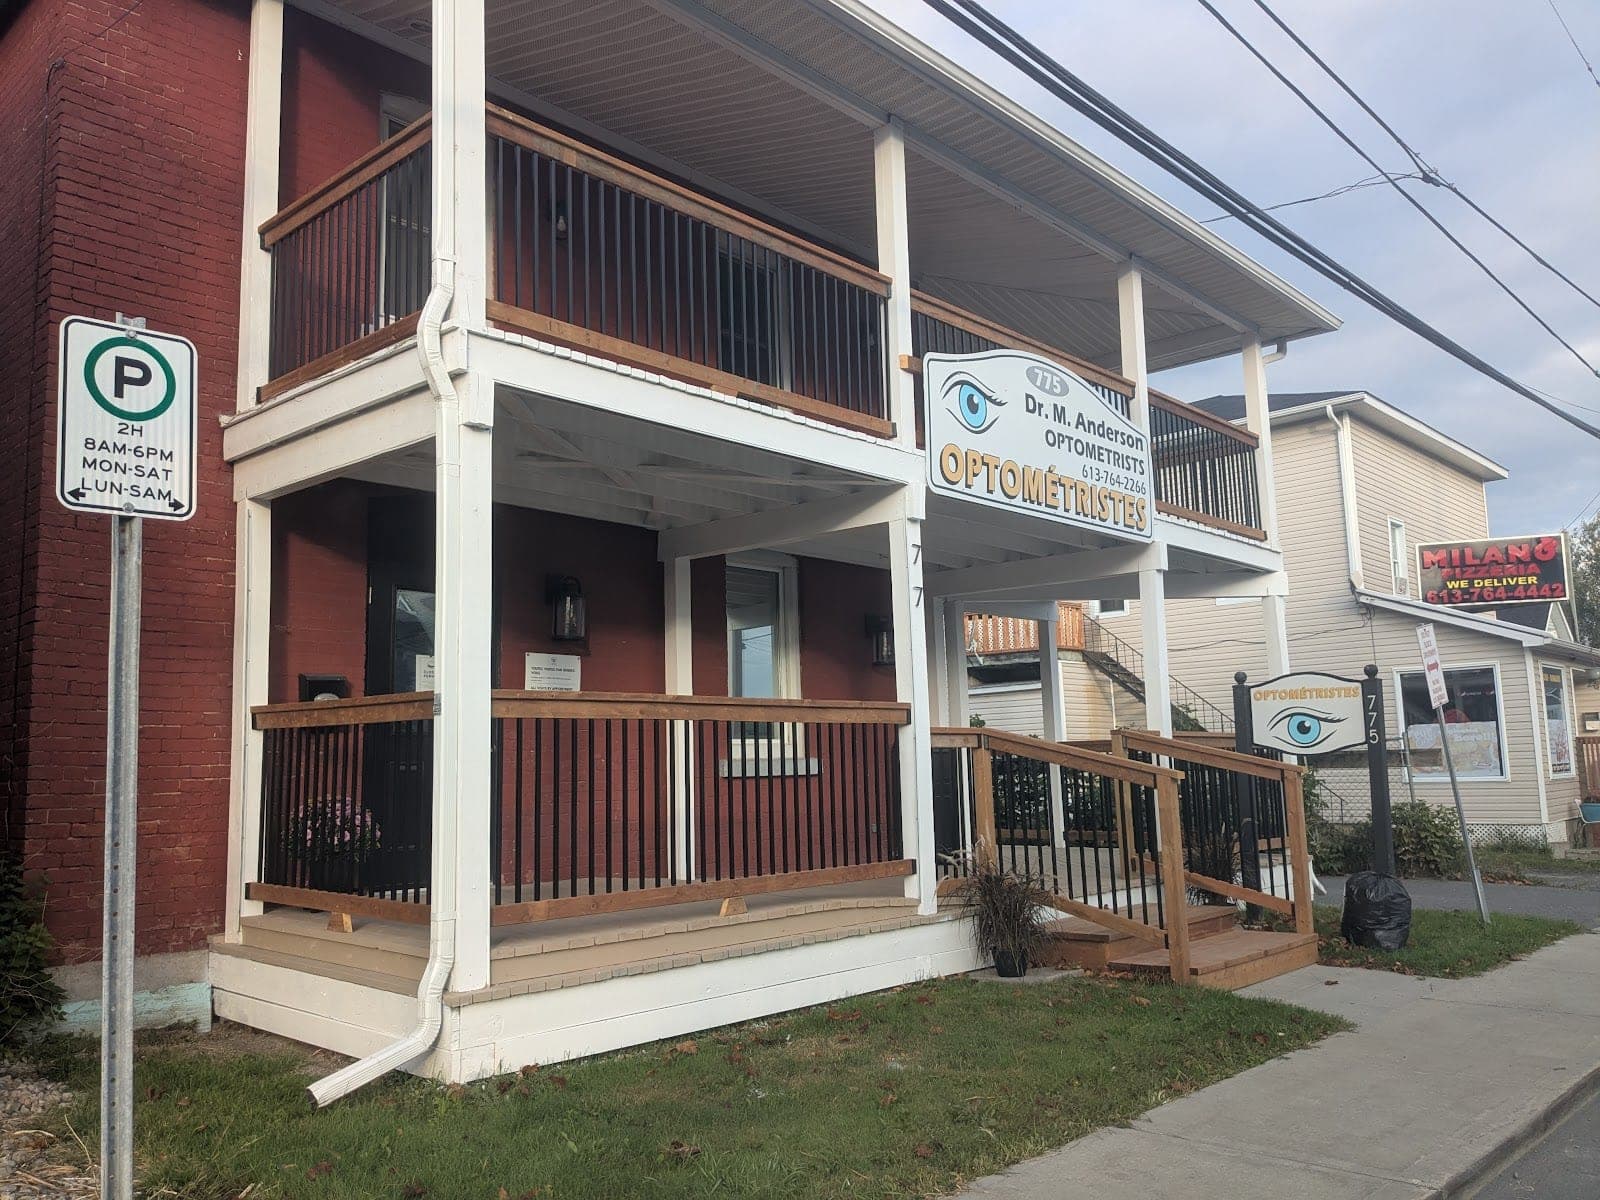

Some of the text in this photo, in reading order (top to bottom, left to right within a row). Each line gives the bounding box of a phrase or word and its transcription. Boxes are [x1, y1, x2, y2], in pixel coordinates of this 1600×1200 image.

[114, 355, 152, 399] P
[1033, 368, 1061, 394] 775
[117, 422, 143, 437] 2H
[1024, 392, 1144, 452] Dr. M. Anderson
[84, 437, 174, 463] 8AM-6PM
[1045, 429, 1145, 476] OPTOMETRISTS
[82, 456, 173, 481] MON-SAT
[1082, 464, 1147, 495] 613-764-2266
[81, 477, 172, 501] LUN-SAM
[939, 443, 1147, 531] OPTOMÉTRISTES
[1422, 536, 1558, 569] MILANO
[1441, 563, 1541, 579] PIZZERIA
[1447, 576, 1538, 589] WE DELIVER
[1426, 583, 1565, 604] 613-764-4442
[1253, 686, 1360, 701] OPTOMÉTRISTES
[1367, 695, 1379, 744] 775
